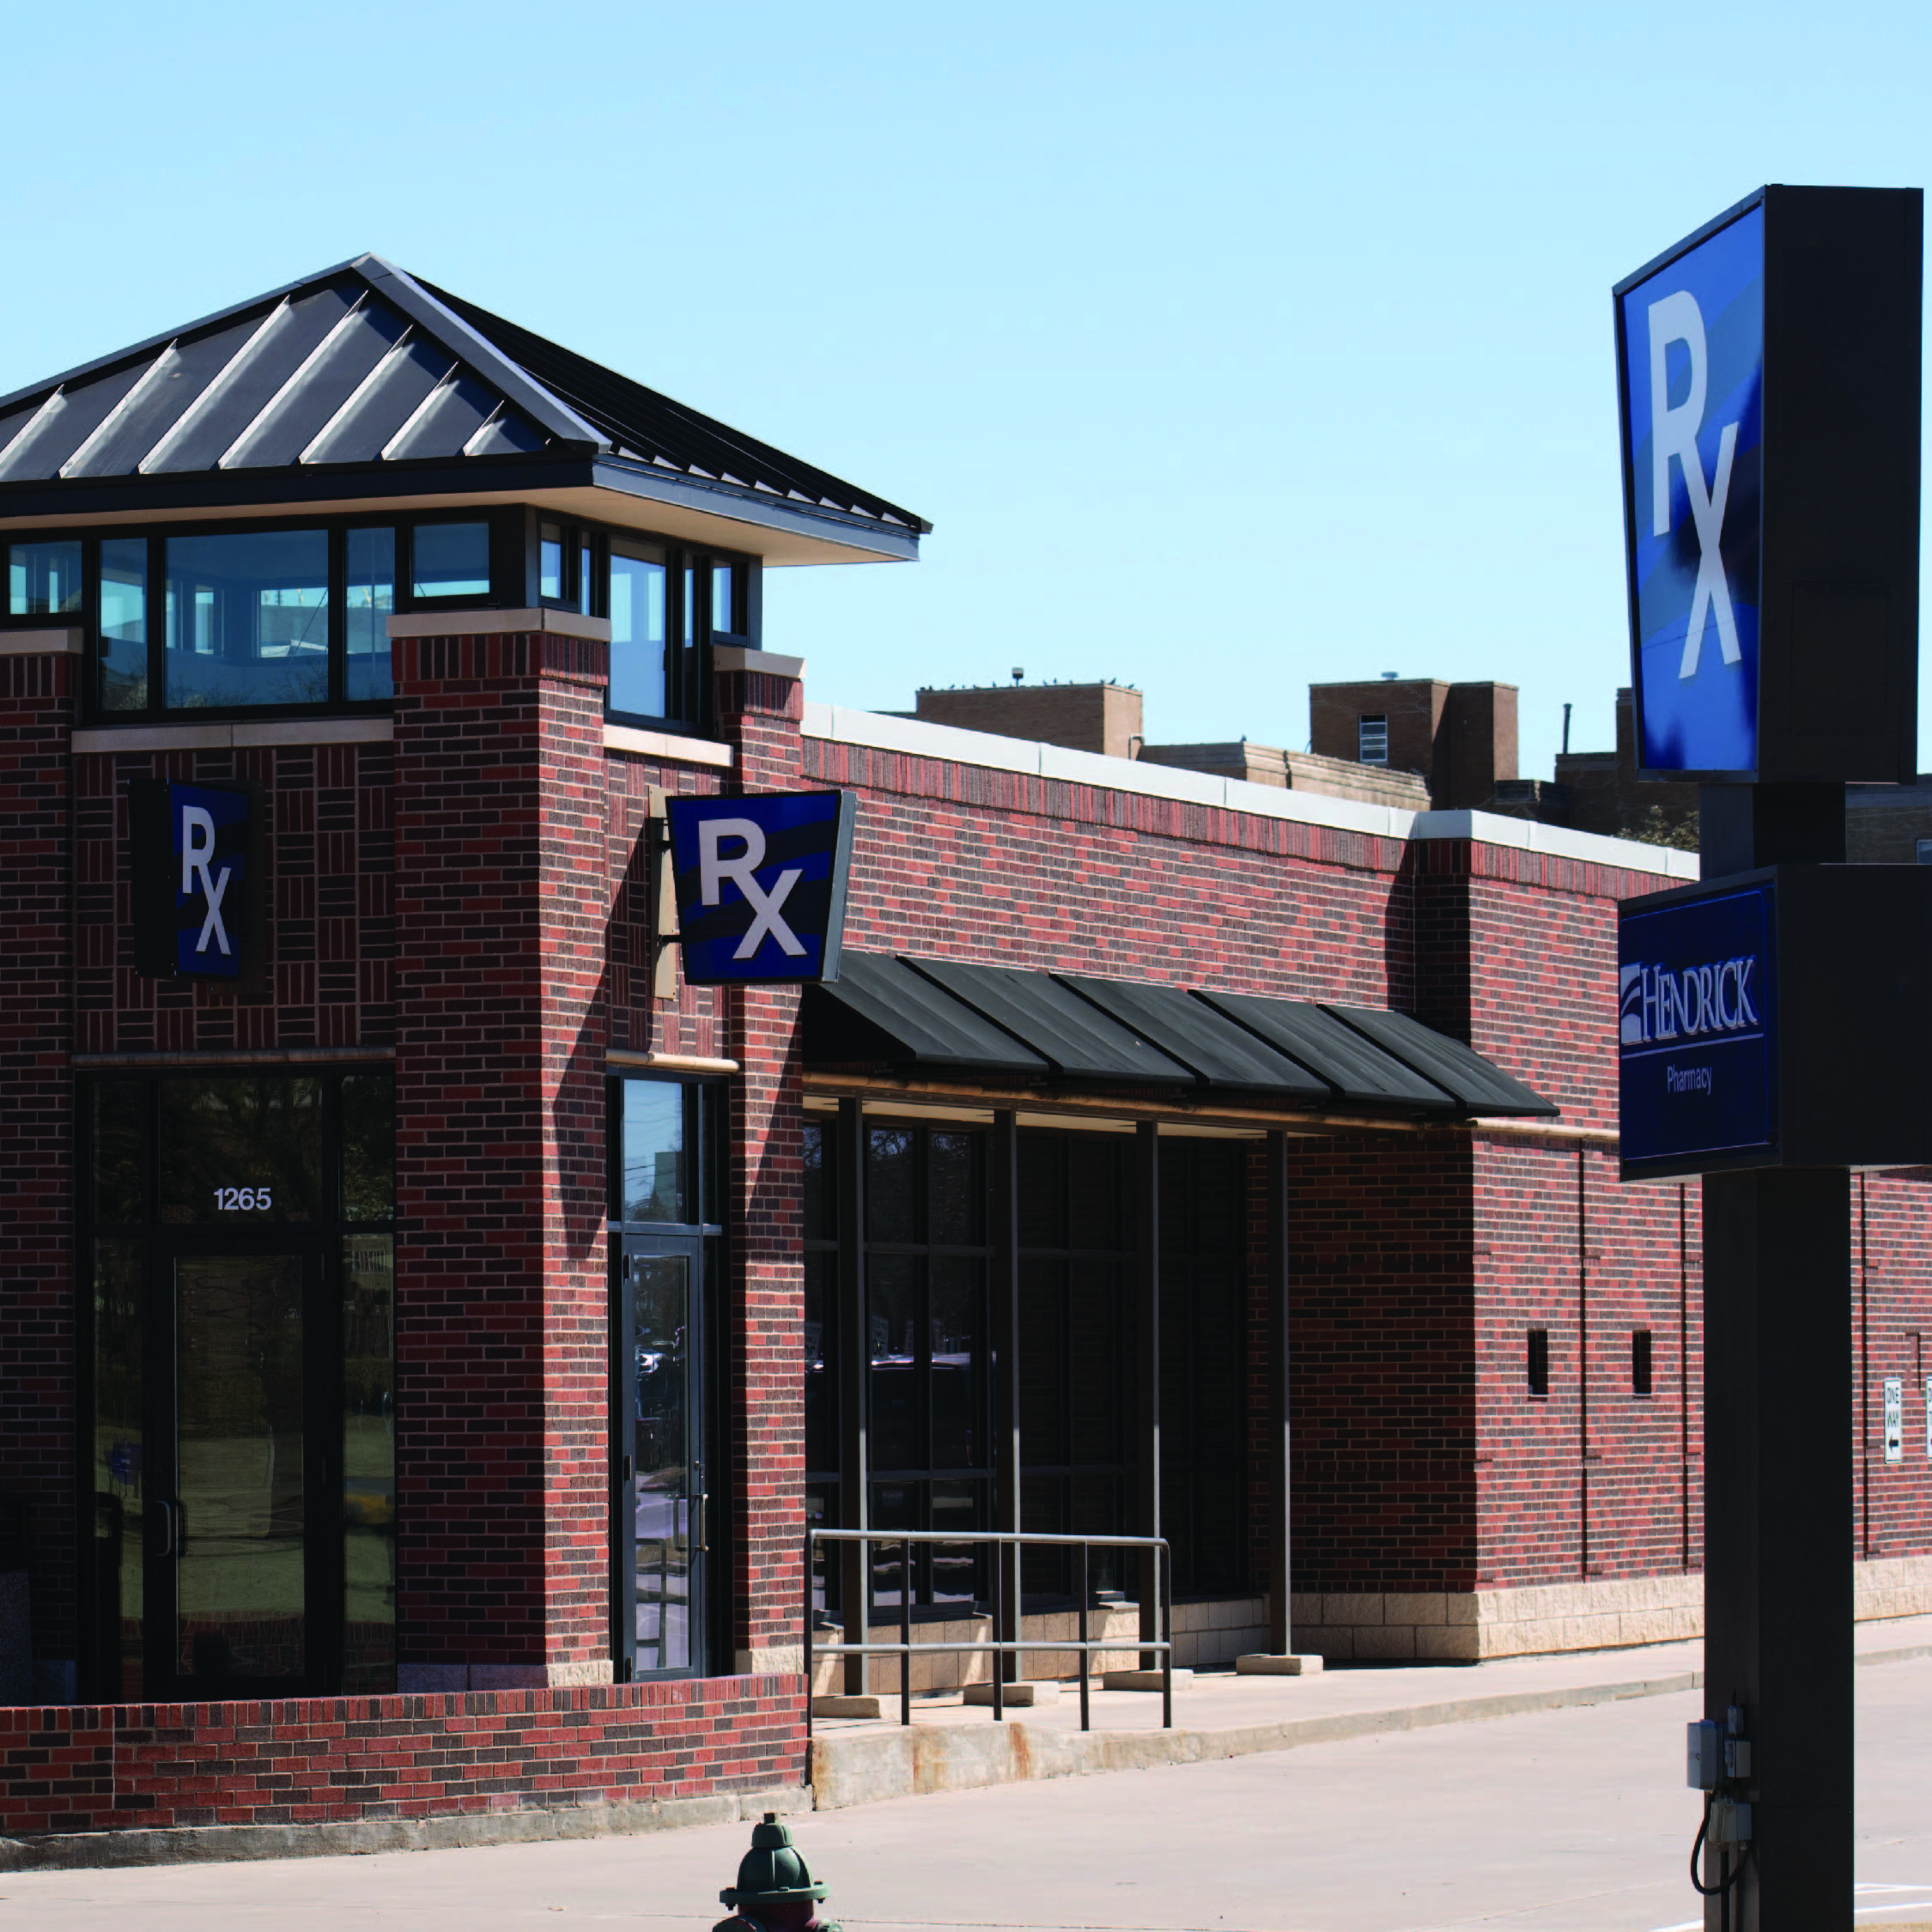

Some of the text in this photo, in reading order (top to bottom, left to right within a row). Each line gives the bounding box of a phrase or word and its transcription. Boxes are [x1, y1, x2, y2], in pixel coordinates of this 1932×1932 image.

[1641, 957, 1759, 1042] HENDRICK
[1667, 1065, 1712, 1096] Pharmacy
[213, 1187, 272, 1211] 1265
[1886, 1387, 1899, 1405] ONE
[1886, 1410, 1899, 1428] WAY
